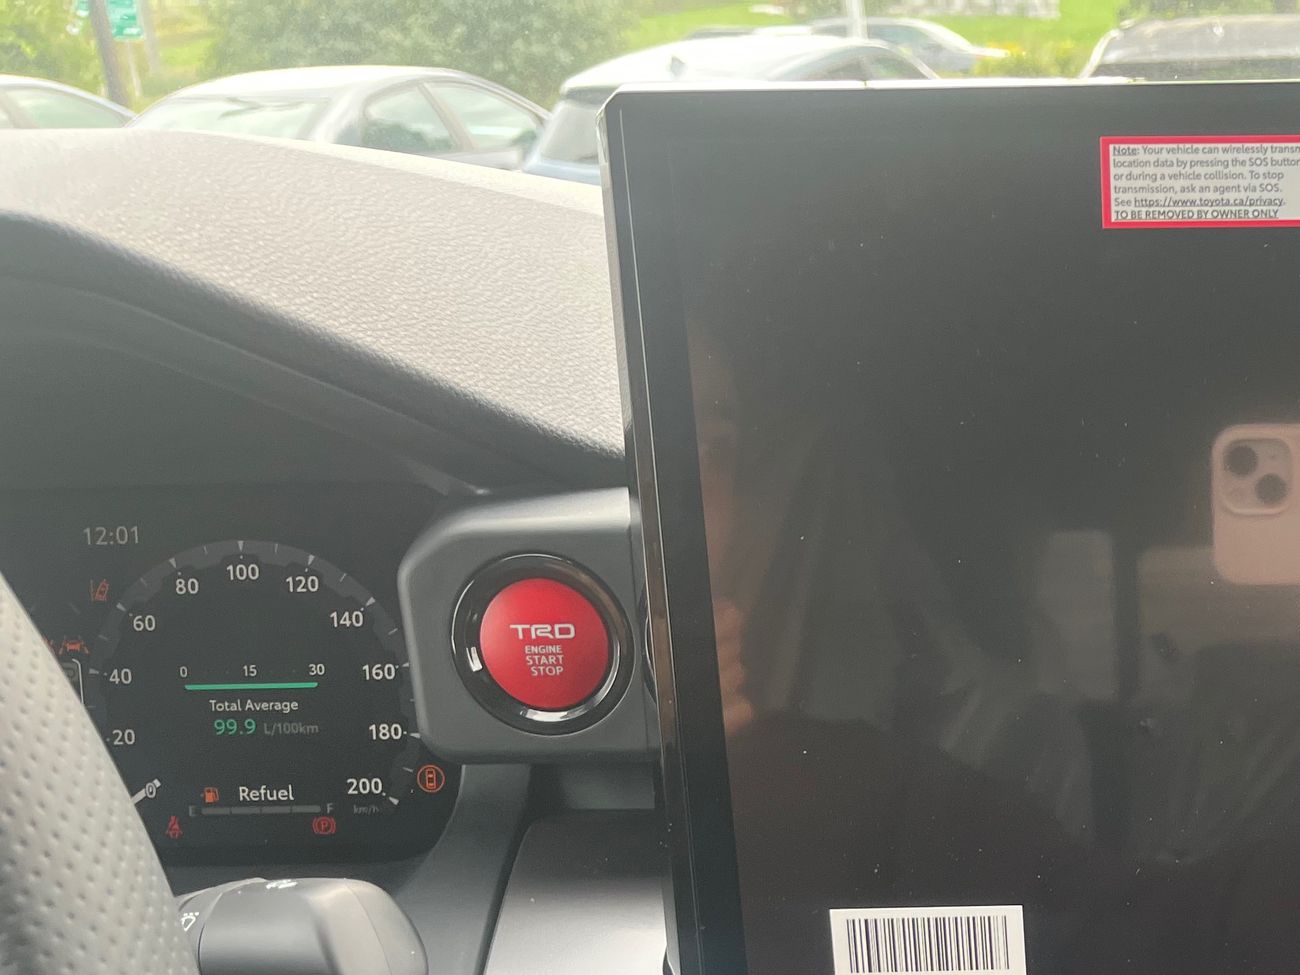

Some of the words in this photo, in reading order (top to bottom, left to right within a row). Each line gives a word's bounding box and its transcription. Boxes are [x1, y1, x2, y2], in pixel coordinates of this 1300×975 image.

[1112, 146, 1140, 156] Note:
[1142, 146, 1164, 154] Your
[1166, 144, 1200, 154] vehicle
[1201, 146, 1219, 154] can
[1221, 144, 1268, 156] wirelessly
[1113, 158, 1151, 168] location
[1153, 158, 1174, 167] data
[1176, 158, 1187, 169] by
[1190, 158, 1229, 169] pressing
[1231, 158, 1246, 167] the
[1248, 157, 1269, 167] SOS
[1125, 171, 1157, 183] during
[1168, 170, 1202, 180] vehicle
[1204, 170, 1246, 180] collision.
[1249, 170, 1260, 179] To
[1263, 171, 1284, 181] stop
[1114, 184, 1177, 194] transmission,
[1180, 184, 1196, 193] ask
[1213, 184, 1241, 195] agent
[1243, 183, 1257, 193] via
[1259, 183, 1282, 192] SOS.
[1114, 197, 1132, 206] See
[1114, 210, 1128, 220] TO
[1131, 210, 1142, 219] BE
[1145, 210, 1194, 219] REMOVED
[1197, 210, 1209, 219] BY
[1211, 209, 1250, 219] OWNER
[1252, 209, 1279, 219] ONLY
[83, 526, 140, 545] 12:01
[226, 565, 259, 581] 100
[175, 578, 199, 594] 80
[286, 576, 319, 593] 120
[133, 616, 156, 631] 60
[330, 611, 364, 628] 140
[510, 624, 575, 640] TRD
[525, 645, 562, 654] ENGINE
[526, 655, 564, 665] START
[109, 668, 132, 684] 40
[180, 666, 188, 677] 0
[242, 665, 257, 677] 15
[309, 664, 325, 676] 30
[362, 664, 395, 680] 160
[531, 666, 563, 676] STOP
[209, 699, 242, 711] Total
[245, 699, 299, 713] Average
[214, 719, 256, 735] 99.9
[264, 722, 318, 735] L/100km
[369, 724, 402, 740] 180
[112, 730, 135, 745] 20
[146, 782, 156, 798] 0
[239, 786, 294, 801] Refuel
[347, 778, 383, 794] 200
[327, 803, 334, 813] F
